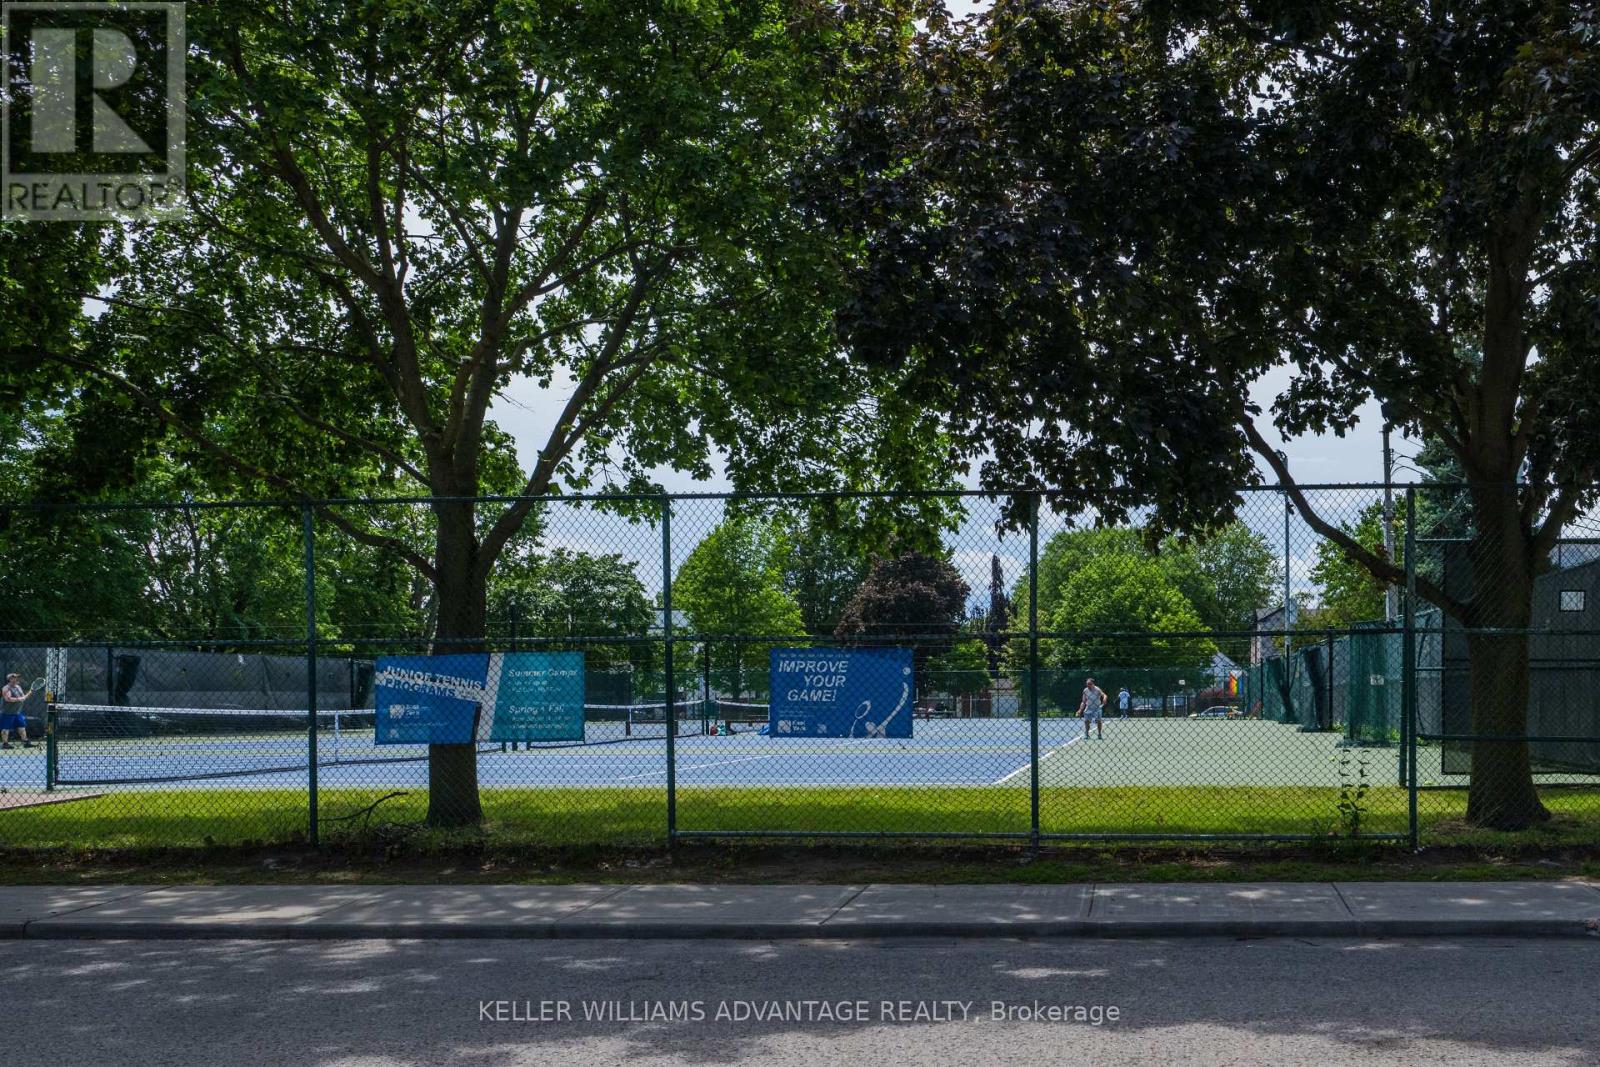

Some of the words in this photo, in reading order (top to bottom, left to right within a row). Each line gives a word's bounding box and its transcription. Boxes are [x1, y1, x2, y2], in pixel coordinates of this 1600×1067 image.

[778, 660, 849, 673] IMPROVE
[384, 677, 457, 698] PROGRAMS
[434, 674, 483, 691] TENNIS
[803, 675, 847, 688] YOUR
[787, 689, 838, 702] GAME!
